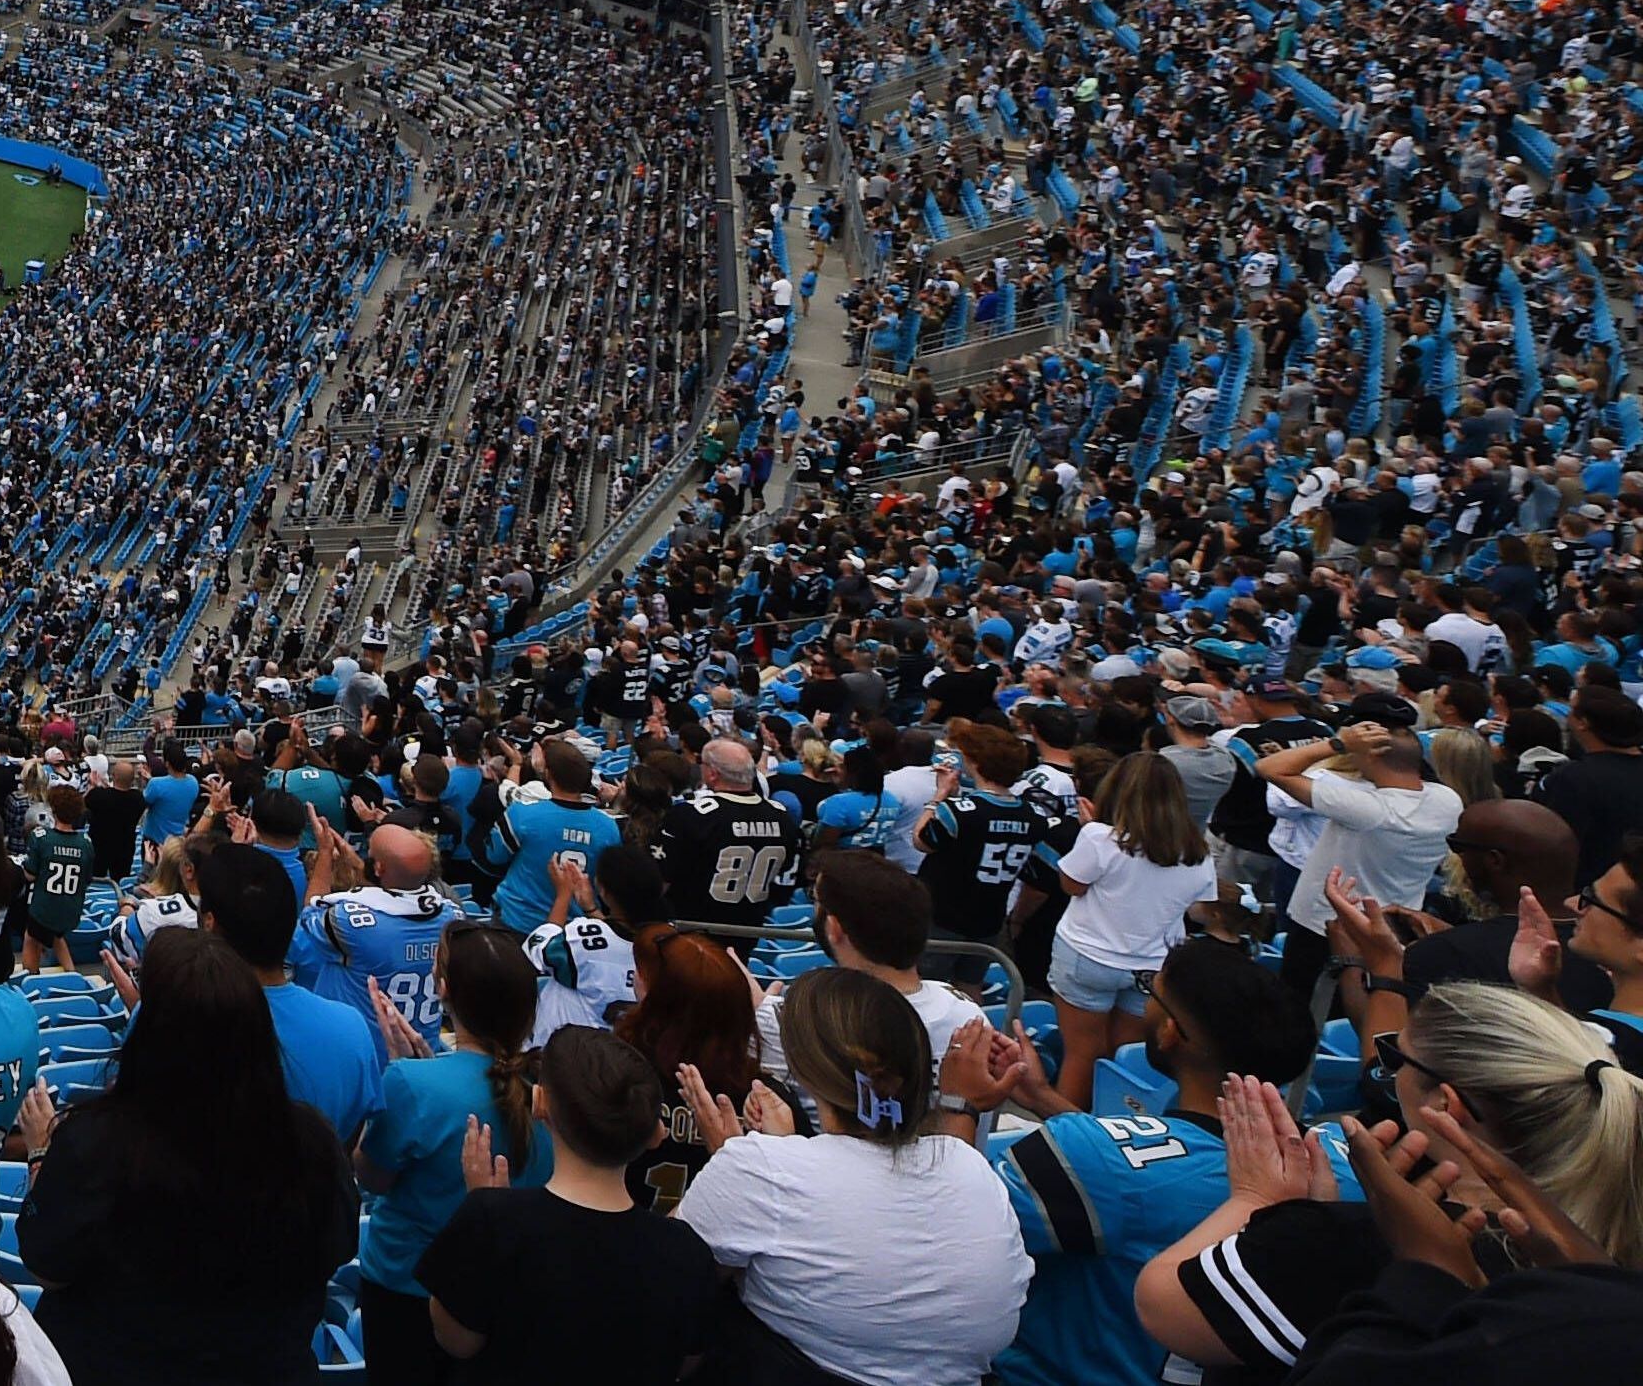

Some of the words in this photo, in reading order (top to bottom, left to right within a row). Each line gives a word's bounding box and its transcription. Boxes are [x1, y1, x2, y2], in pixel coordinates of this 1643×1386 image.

[46, 861, 81, 896] 26
[709, 844, 787, 904] 80
[976, 842, 1033, 885] 59
[405, 942, 438, 962] OLS
[1102, 1114, 1189, 1170] 21
